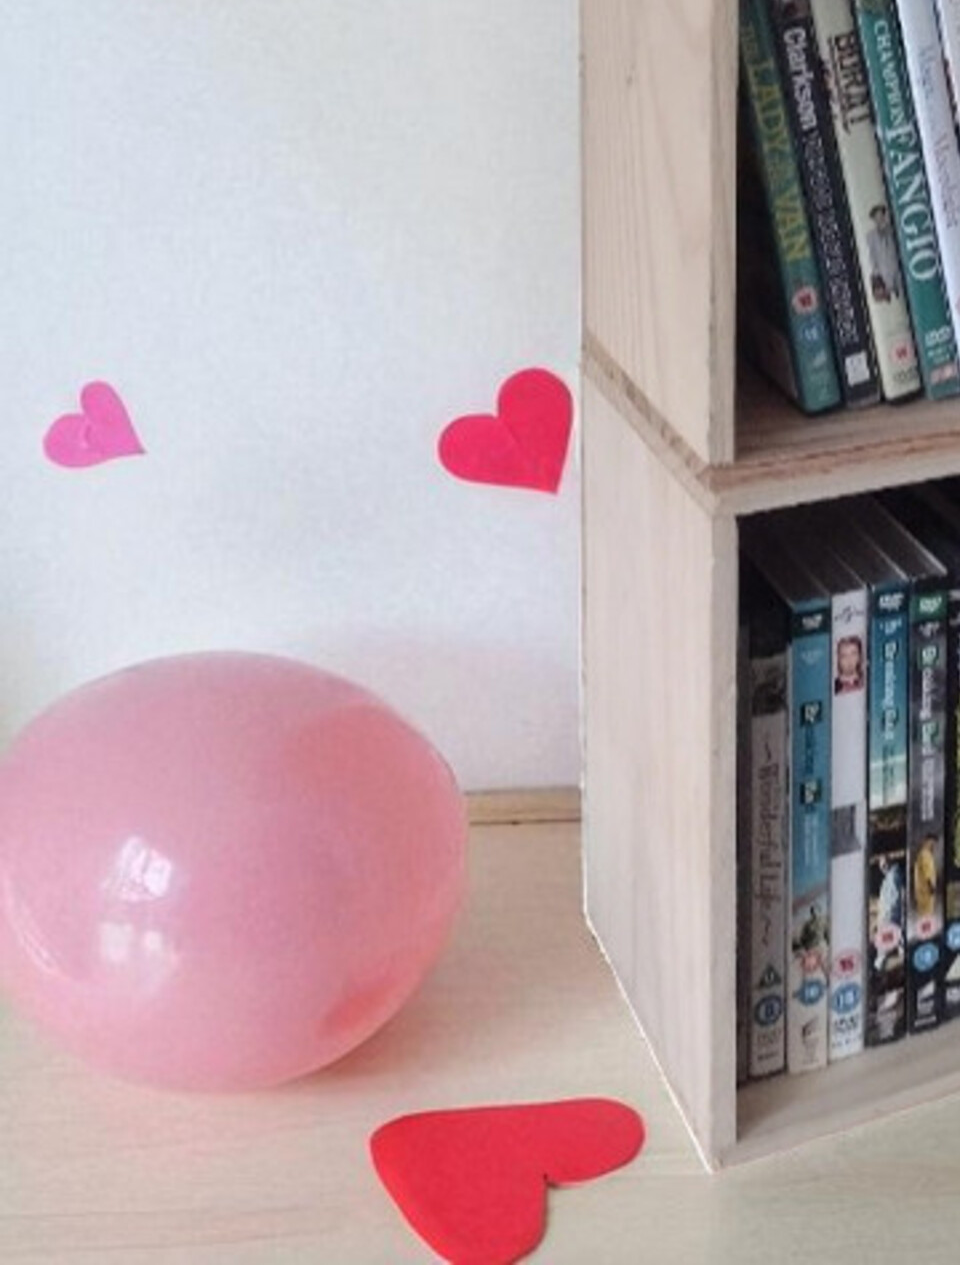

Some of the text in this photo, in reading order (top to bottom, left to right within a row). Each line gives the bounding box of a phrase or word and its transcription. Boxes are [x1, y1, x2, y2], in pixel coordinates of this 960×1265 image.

[783, 26, 818, 132] Clarkson
[874, 20, 942, 280] CHAMPION FANGIO
